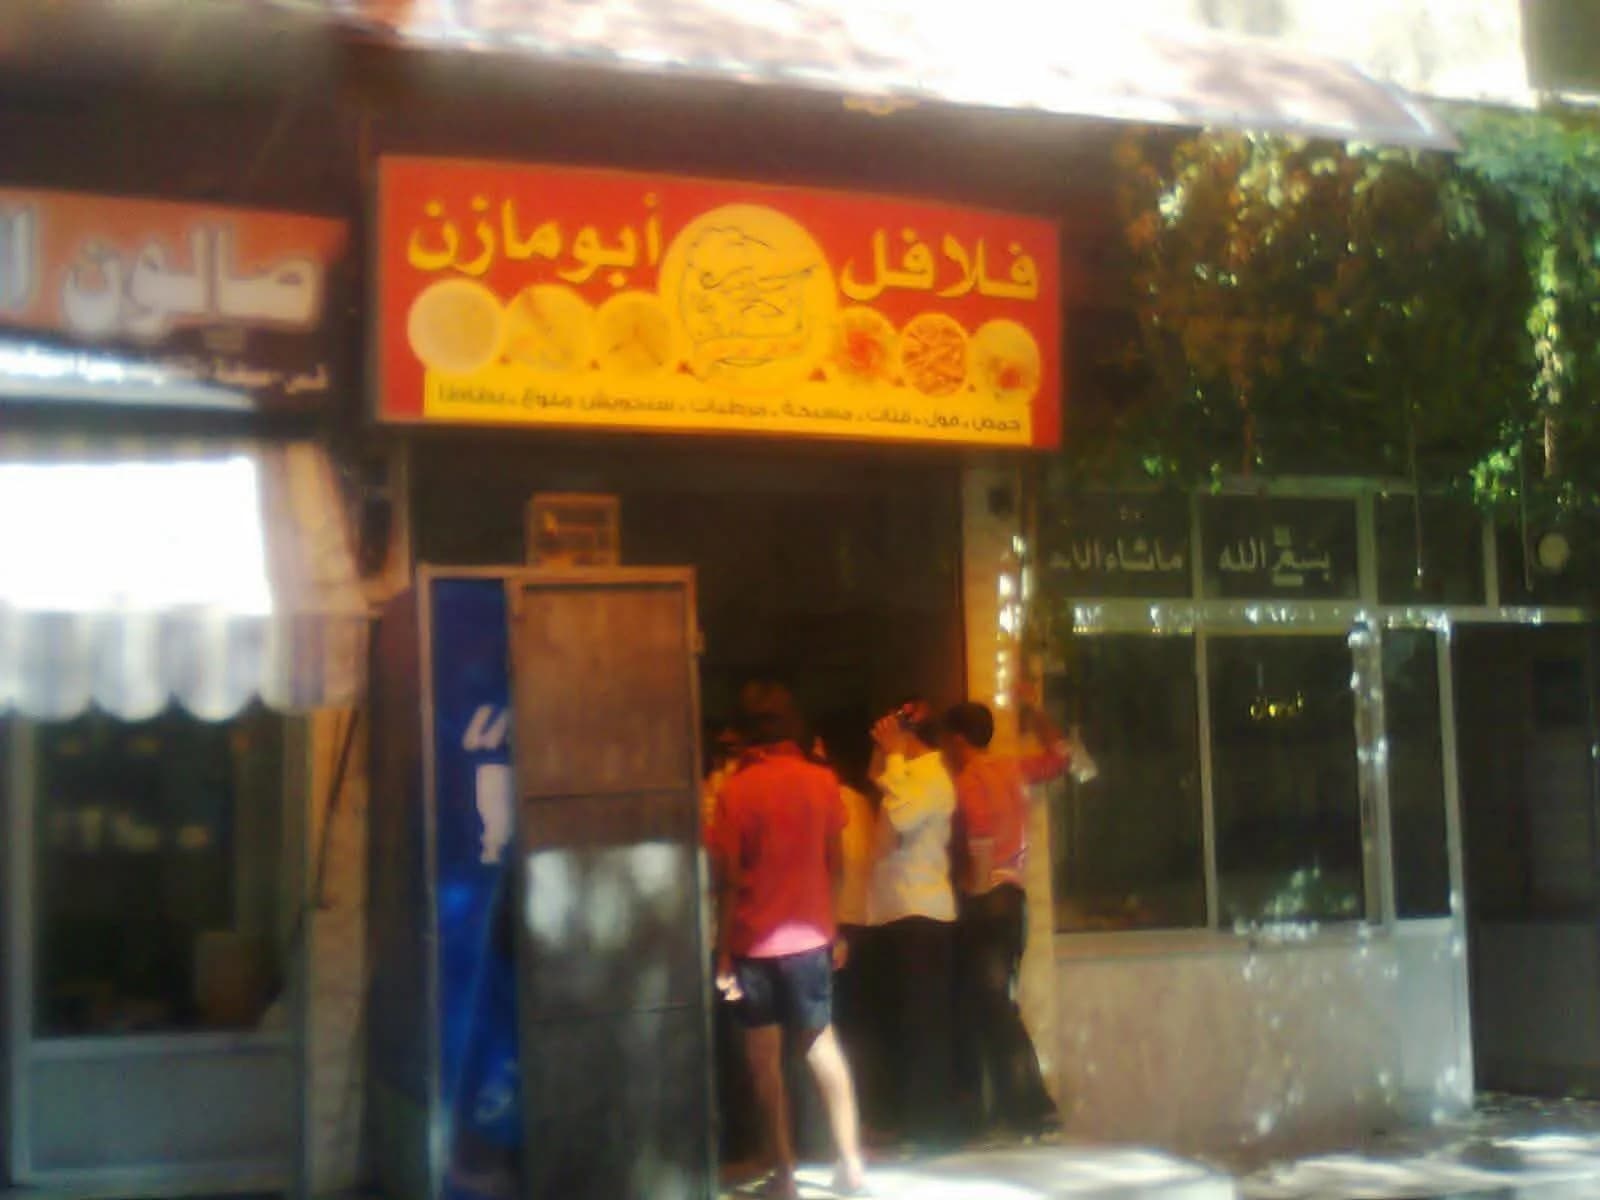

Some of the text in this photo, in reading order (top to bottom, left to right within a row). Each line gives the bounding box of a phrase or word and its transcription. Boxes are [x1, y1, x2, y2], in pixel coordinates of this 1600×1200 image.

[407, 194, 562, 277] مازن
[840, 227, 1038, 301] فلافل
[972, 414, 1021, 431] حمص
[1219, 535, 1266, 573] الله
